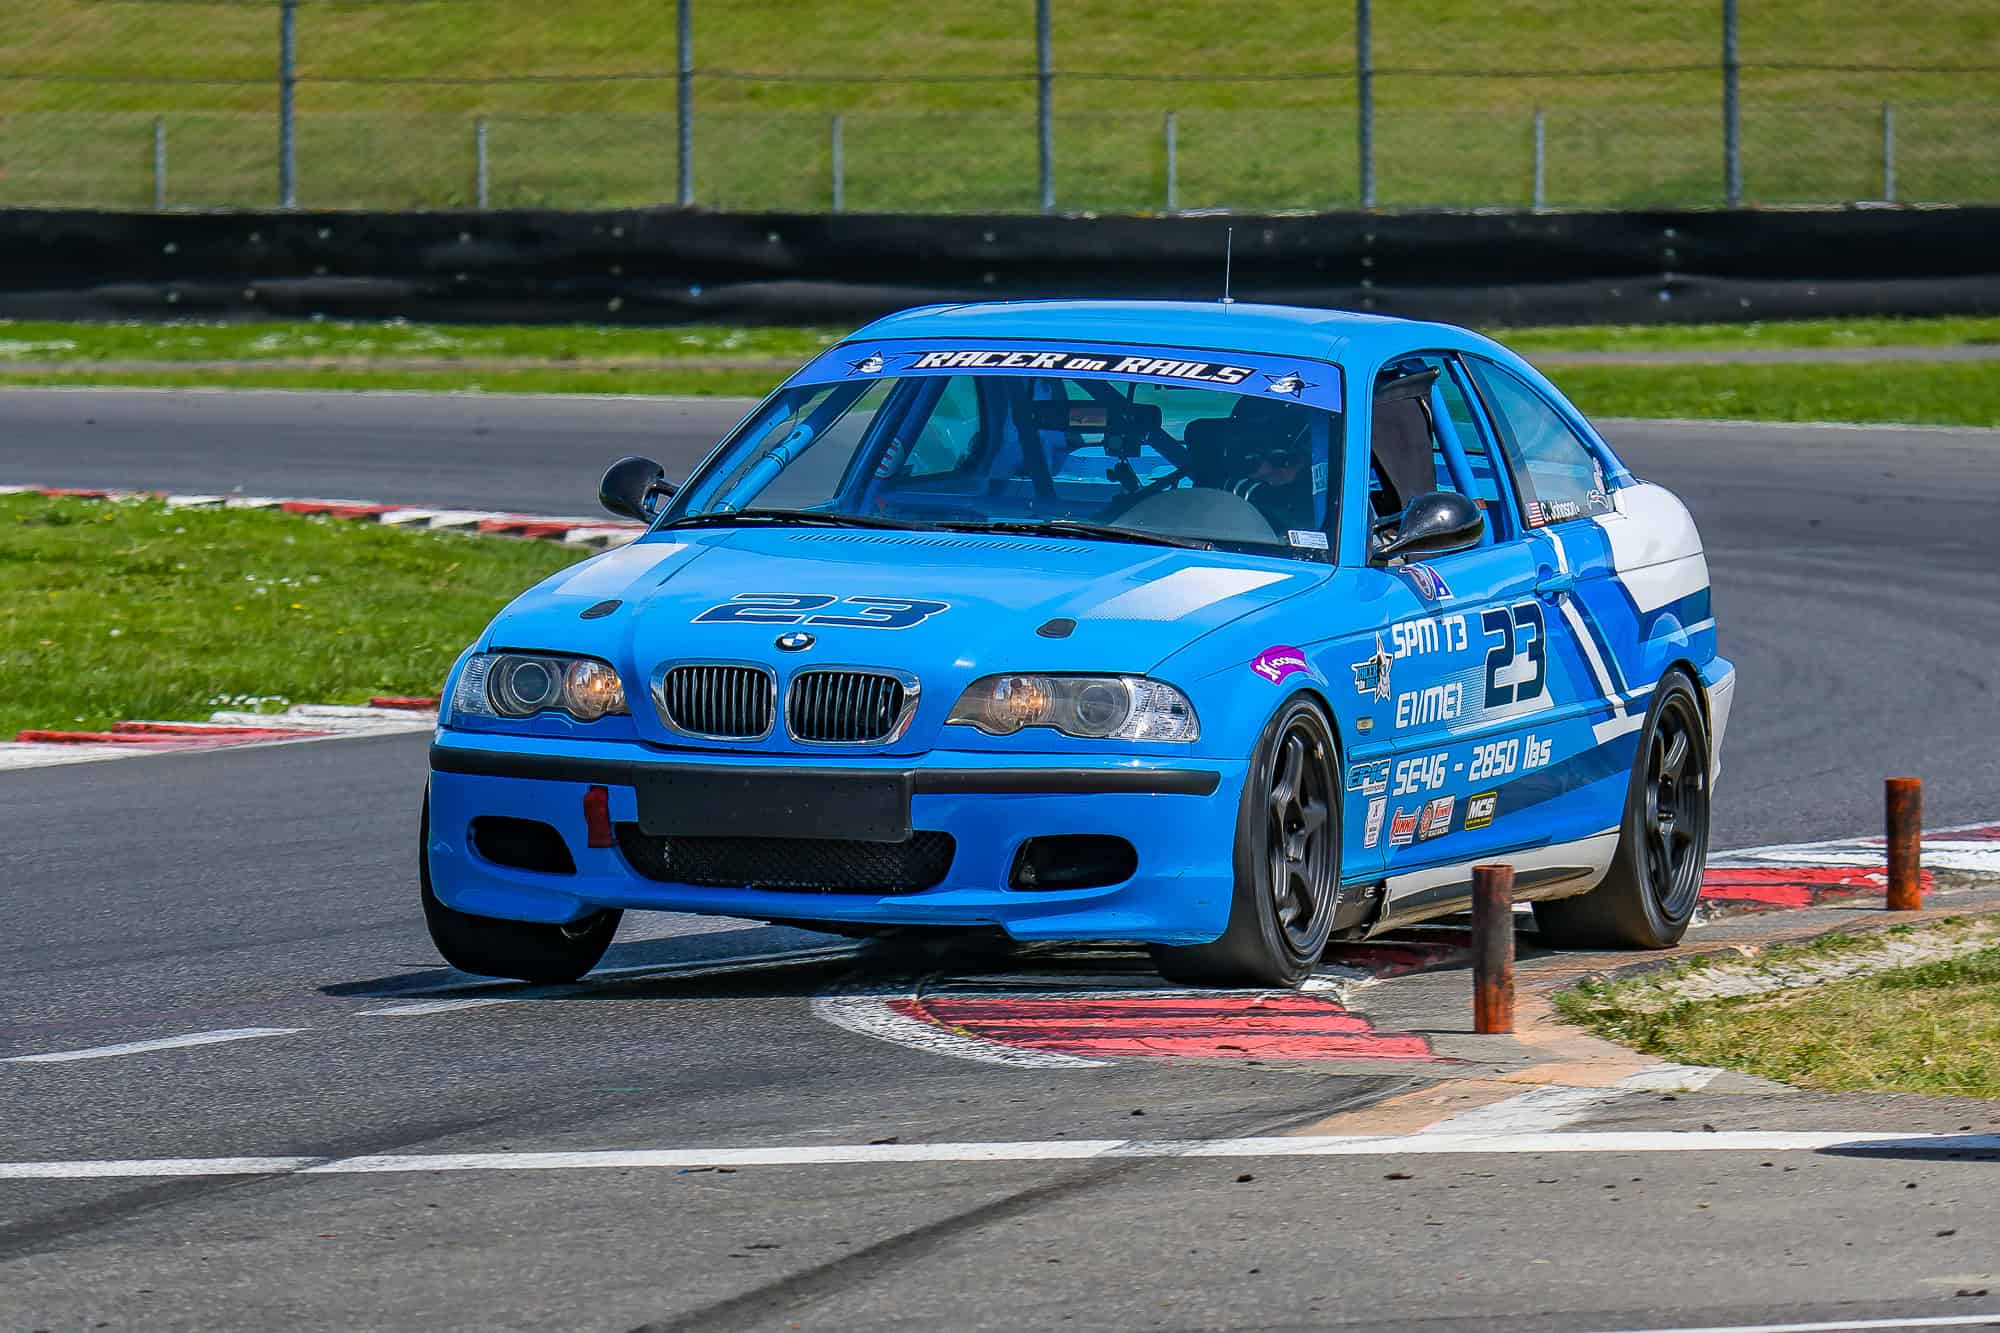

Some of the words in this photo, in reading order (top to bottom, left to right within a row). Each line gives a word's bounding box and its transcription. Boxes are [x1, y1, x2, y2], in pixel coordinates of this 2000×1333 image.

[914, 352, 1068, 369] RACER
[1063, 358, 1107, 371] on
[1113, 357, 1251, 384] RAILS
[690, 592, 951, 630] 23
[1392, 619, 1439, 659] SPM
[1442, 615, 1468, 652] T3
[1481, 601, 1546, 711] 23
[1392, 753, 1449, 796] SE46
[1468, 739, 1519, 781] 2850
[1522, 735, 1553, 770] lbs
[1468, 797, 1494, 819] MCS
